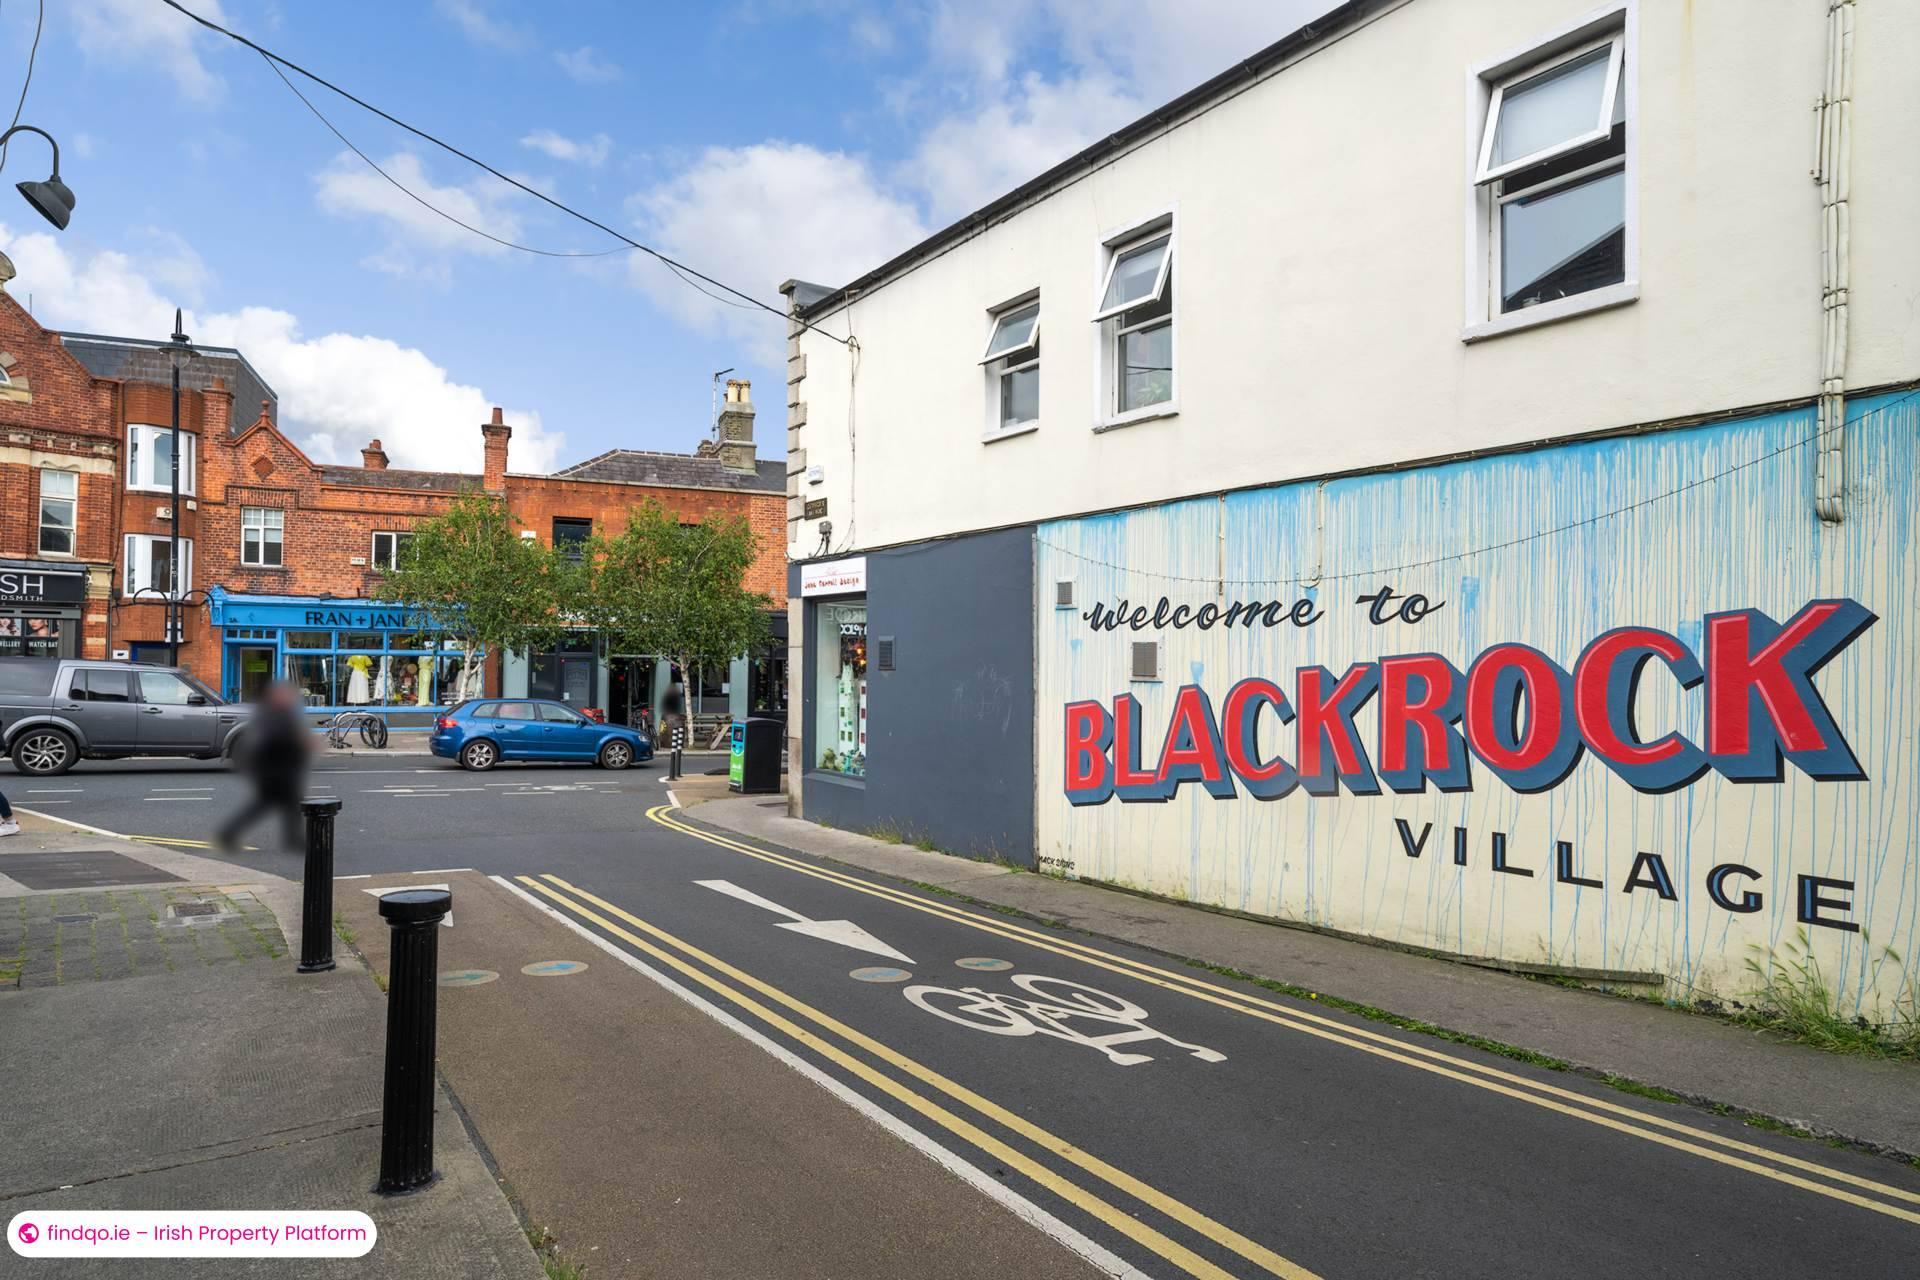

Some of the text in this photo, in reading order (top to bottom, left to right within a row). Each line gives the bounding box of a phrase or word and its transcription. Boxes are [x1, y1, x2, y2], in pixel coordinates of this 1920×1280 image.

[0, 574, 44, 594] SH
[305, 611, 352, 626] FRAN
[1083, 585, 1447, 632] welcome to
[1064, 598, 1880, 807] BLACKROCK
[1395, 818, 1860, 933] VILLAGE
